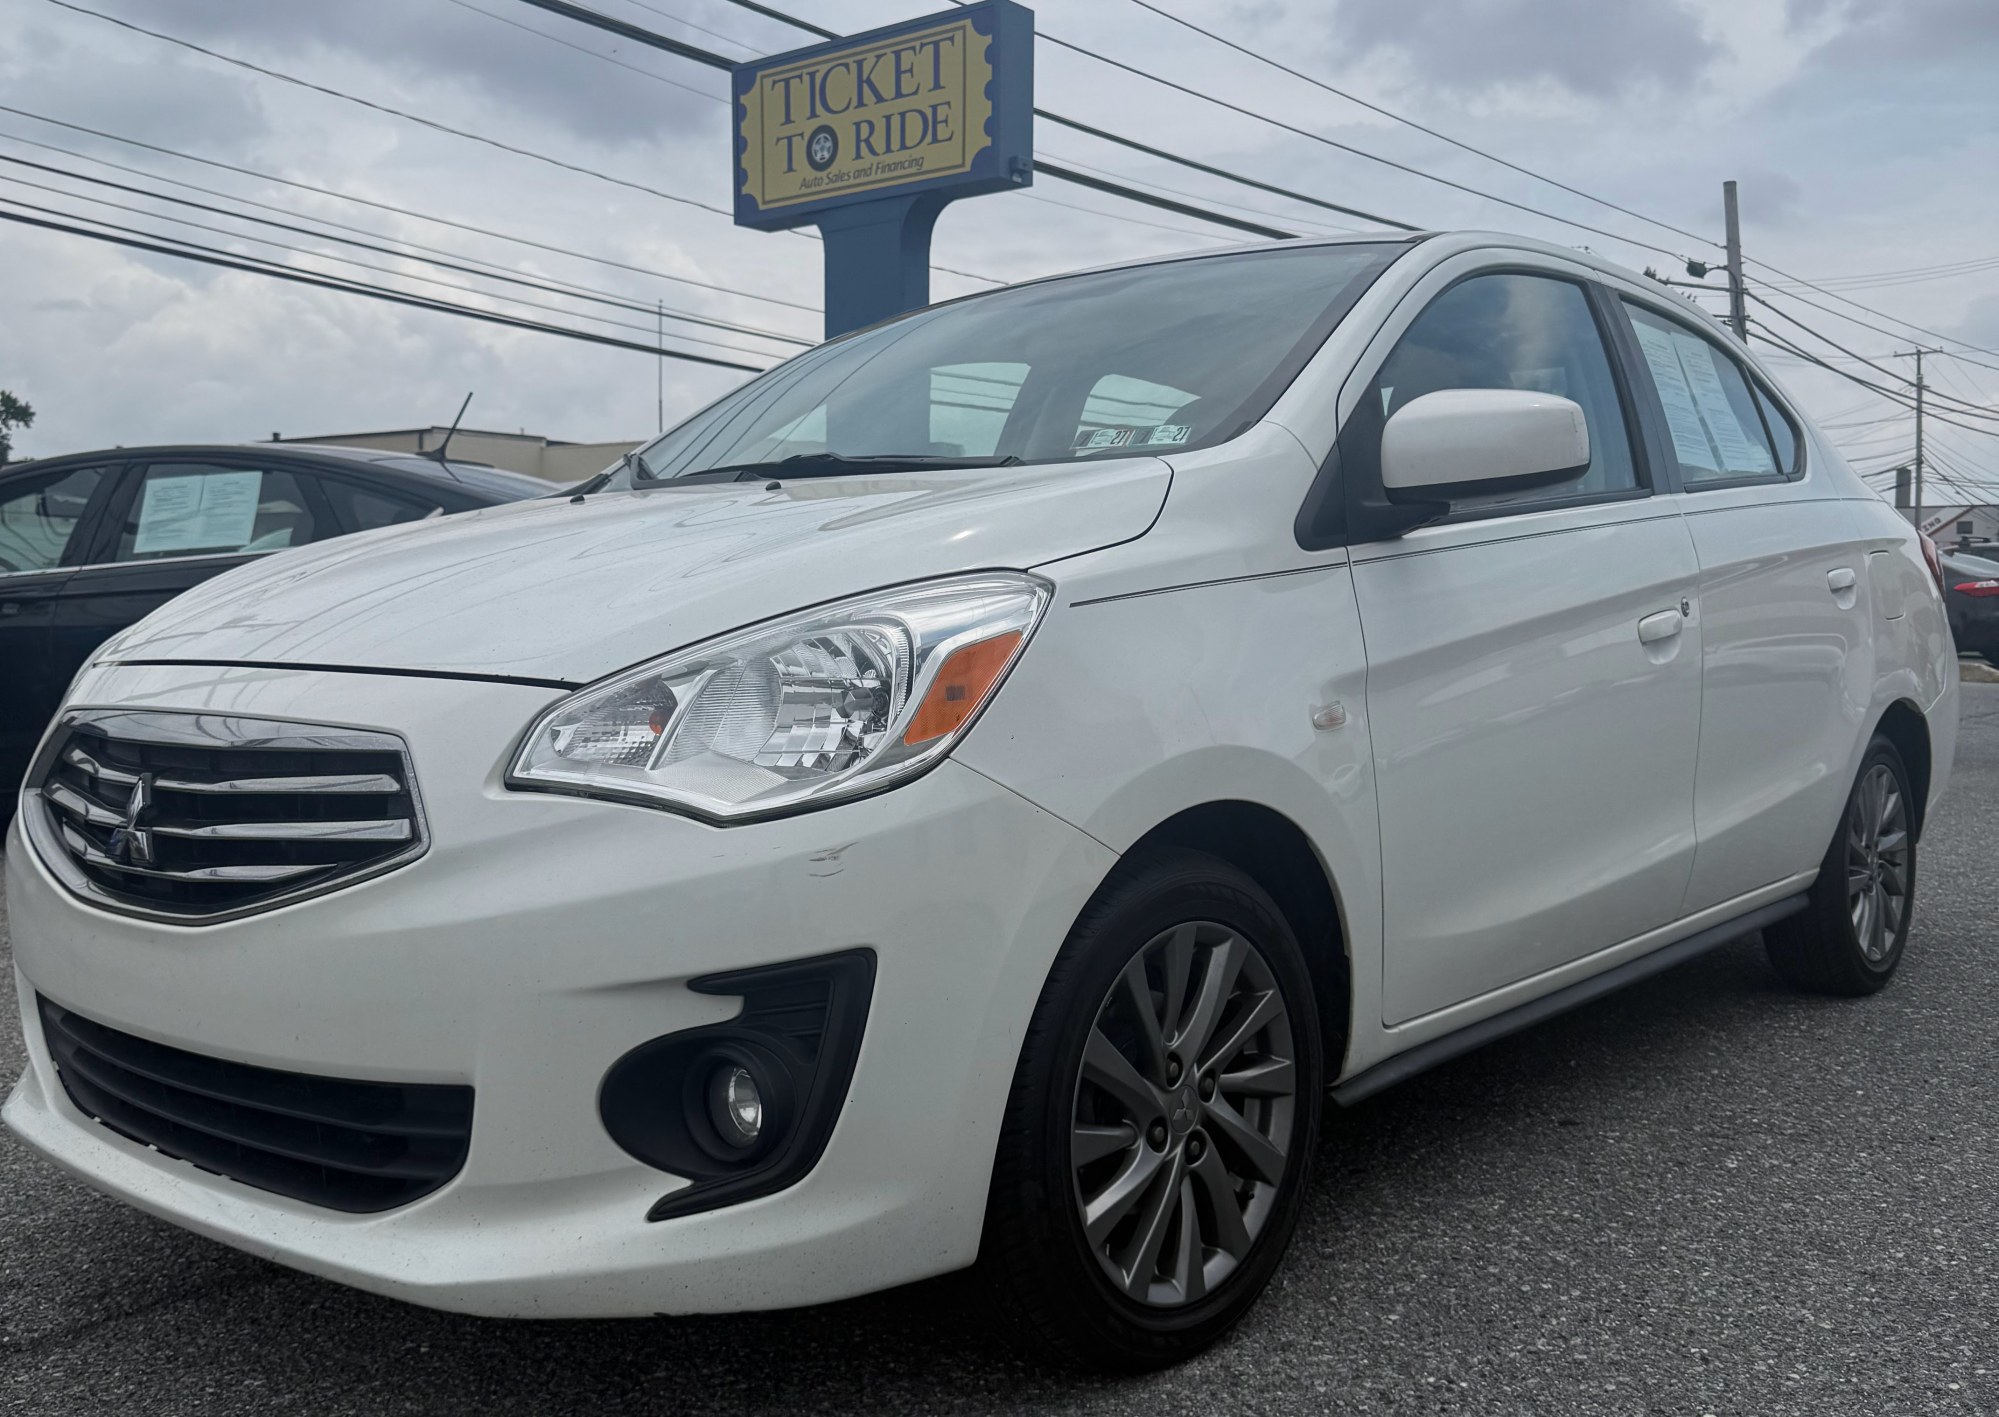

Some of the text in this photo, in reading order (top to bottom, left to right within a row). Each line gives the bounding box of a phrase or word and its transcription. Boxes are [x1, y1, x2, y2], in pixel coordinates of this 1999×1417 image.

[770, 34, 955, 127] TICKET
[775, 101, 954, 175] TO RIDE
[799, 154, 925, 190] Auto Sales and Financing
